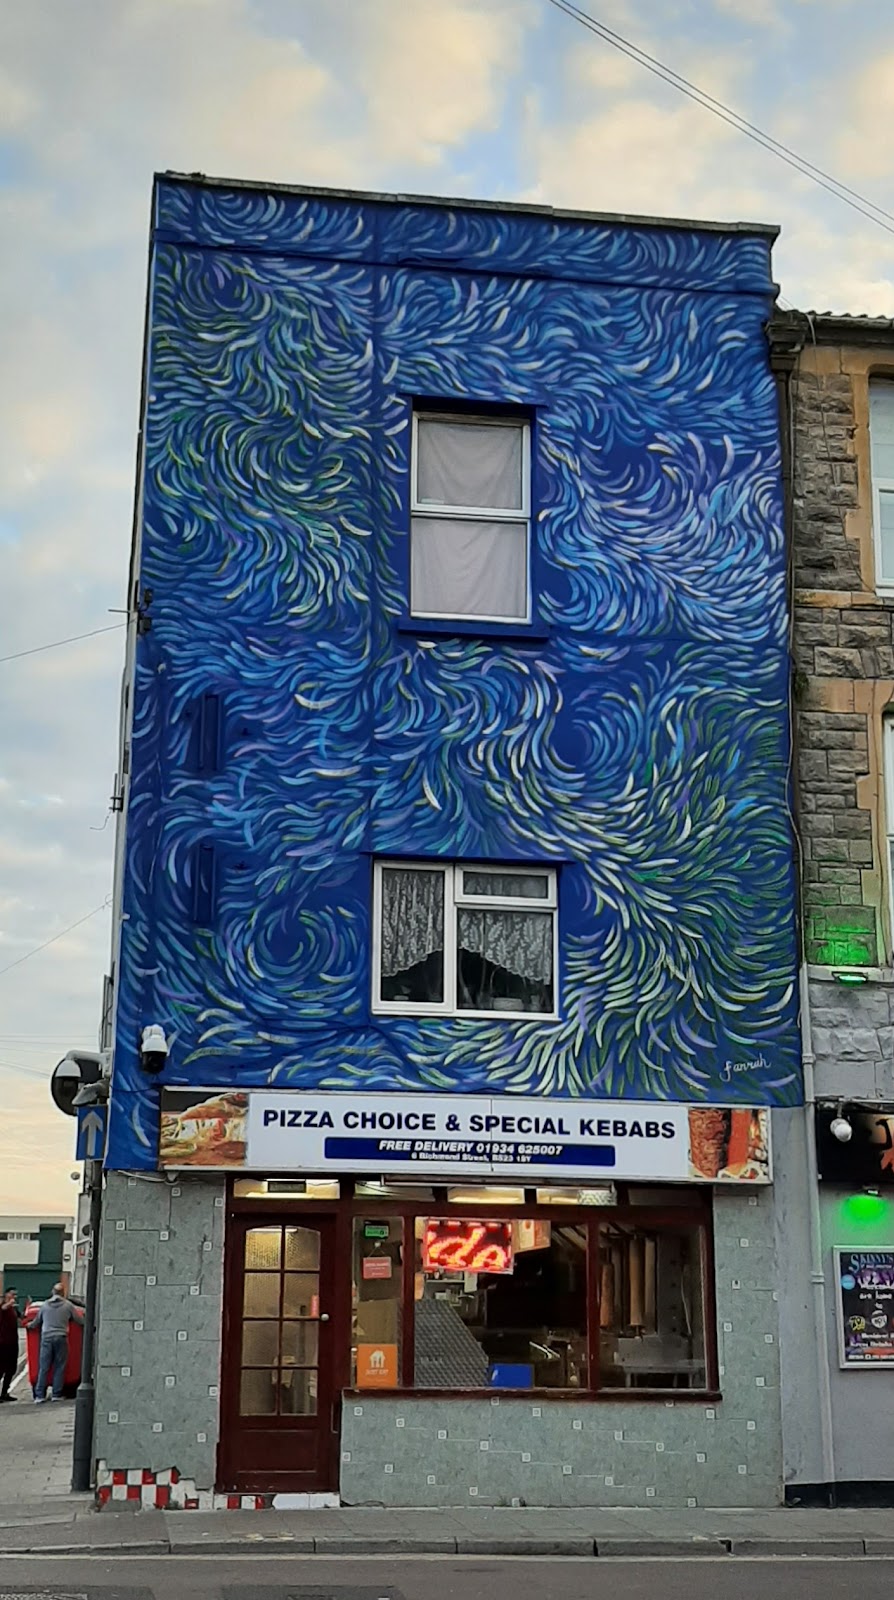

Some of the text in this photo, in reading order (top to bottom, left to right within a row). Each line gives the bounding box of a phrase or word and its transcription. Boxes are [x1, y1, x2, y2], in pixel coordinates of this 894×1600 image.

[263, 1109, 676, 1138] PIZZA CHOICE & SPECIAL KEBABS
[379, 1140, 563, 1155] FREE DELIVERY 01934 625007
